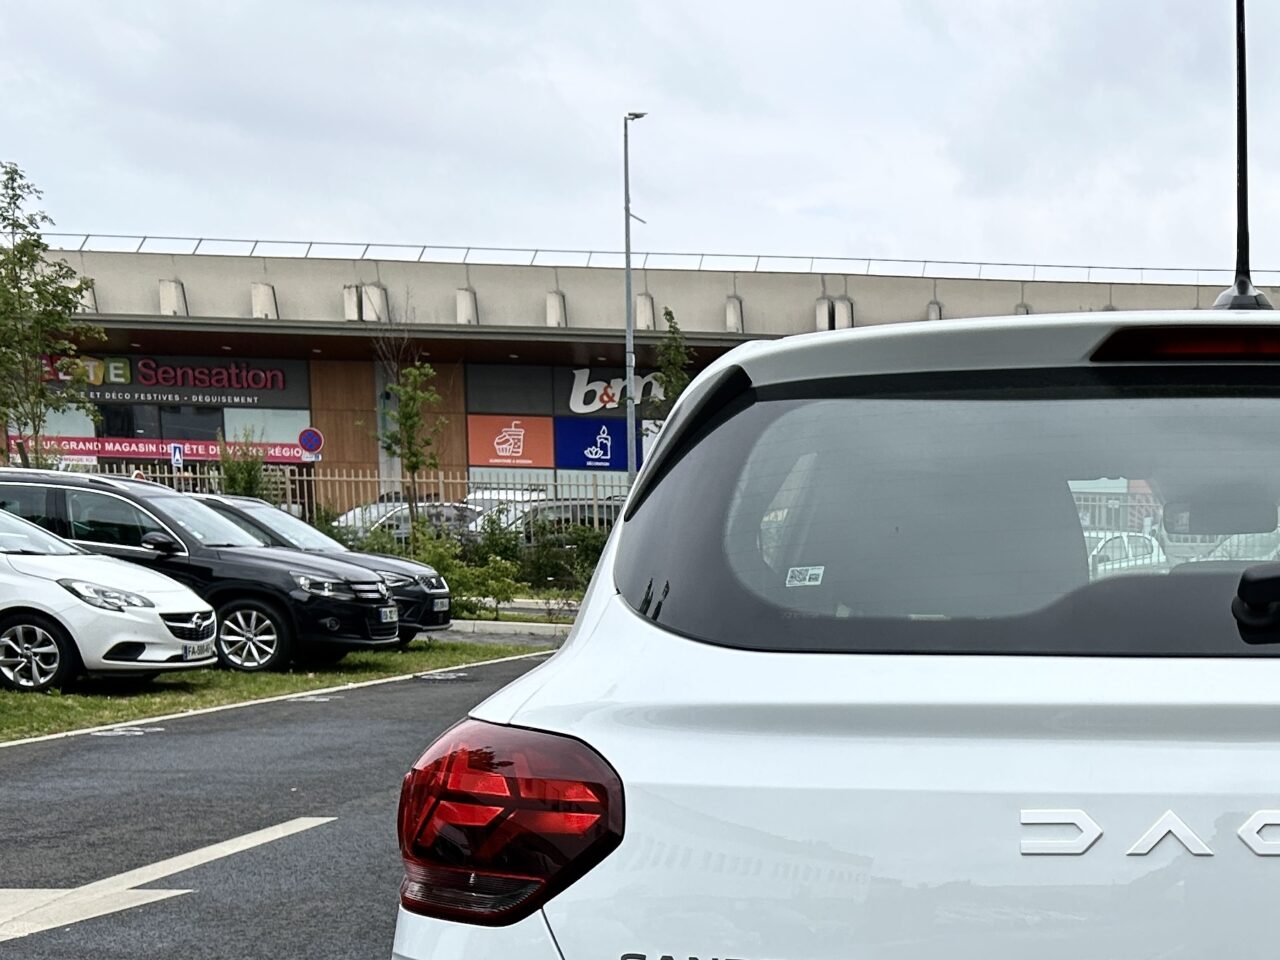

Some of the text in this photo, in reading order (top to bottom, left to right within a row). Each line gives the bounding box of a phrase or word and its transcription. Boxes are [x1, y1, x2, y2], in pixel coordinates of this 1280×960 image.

[138, 358, 285, 389] Sensation
[89, 391, 101, 399] ET
[105, 390, 131, 400] DÉCO
[134, 392, 180, 401] FESTIVES
[569, 368, 666, 414] b&m
[61, 441, 102, 451] GRAND
[105, 442, 157, 452] MAGASIN
[267, 445, 304, 457] RÉGIO
